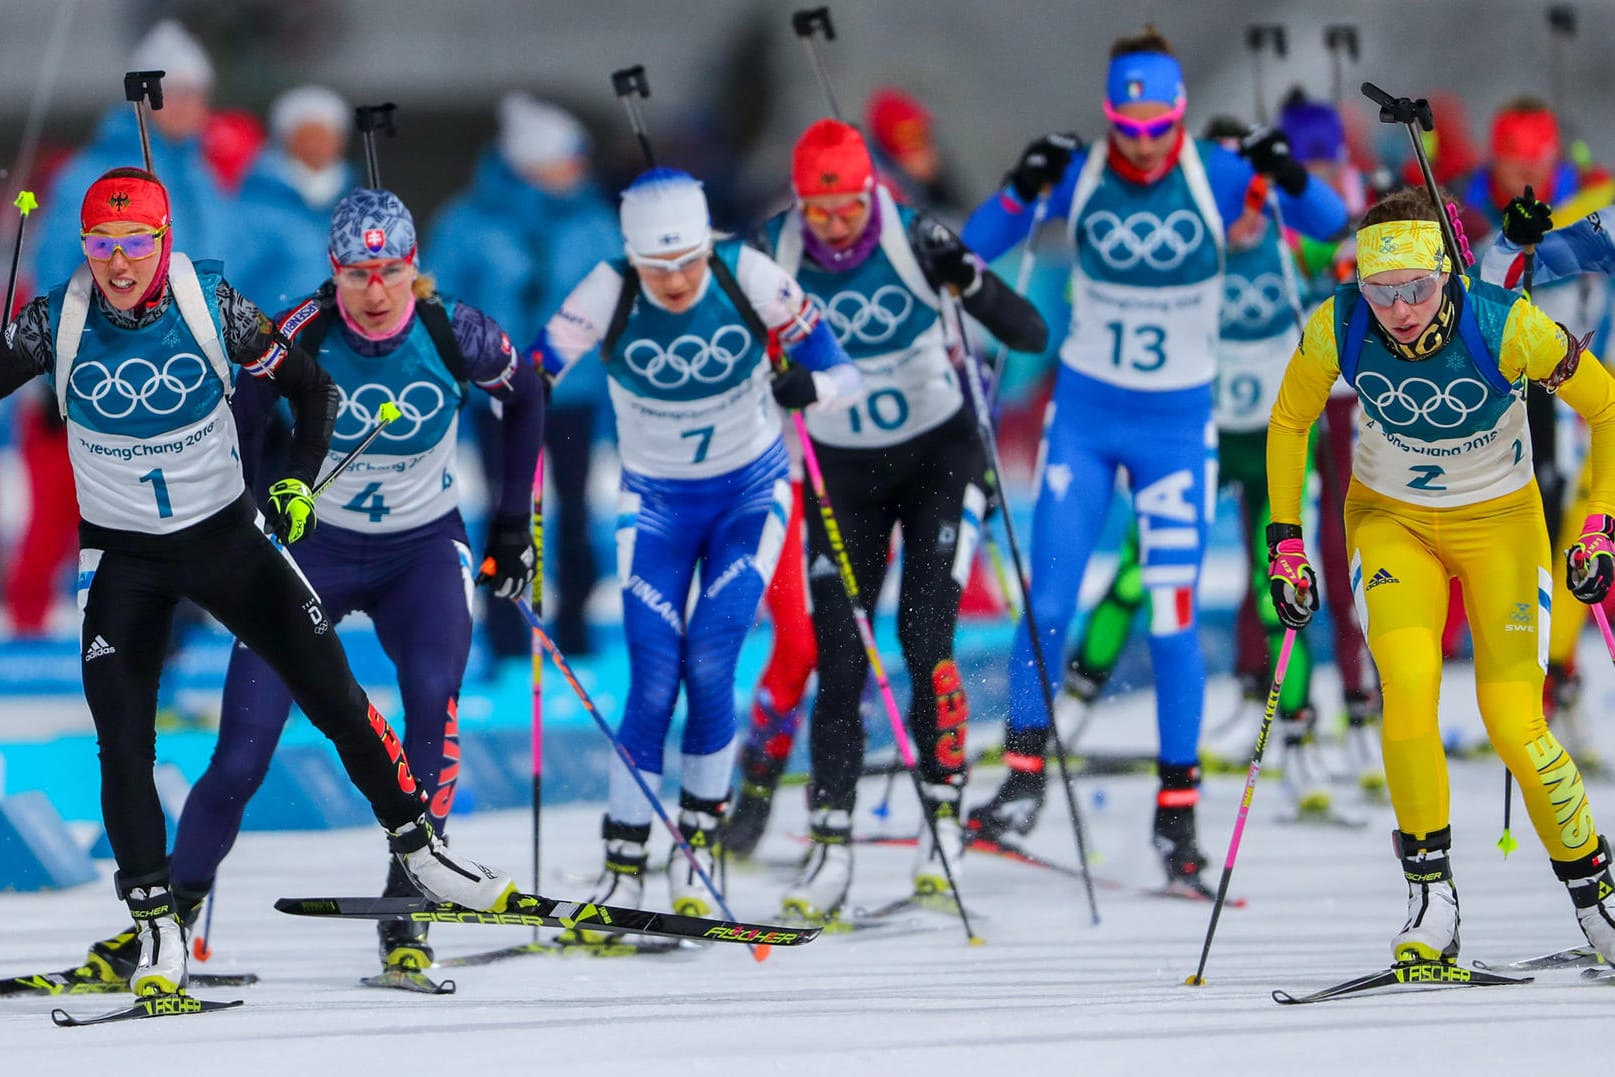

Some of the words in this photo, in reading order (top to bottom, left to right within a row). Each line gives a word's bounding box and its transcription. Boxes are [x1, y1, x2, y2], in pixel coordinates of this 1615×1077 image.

[1107, 321, 1166, 372] 13
[849, 388, 909, 433] 10
[680, 425, 715, 464] 7
[139, 468, 174, 518] 1
[1405, 465, 1448, 491] 2
[341, 481, 391, 523] 4
[1136, 468, 1199, 585] ITA
[1365, 578, 1400, 591] adidas
[1504, 623, 1535, 633] SWE
[85, 646, 116, 662] adidas
[1524, 731, 1597, 850] SWE
[703, 925, 798, 945] FISCHER
[1409, 965, 1472, 983] FISCHER
[155, 997, 202, 1014] FISCHER
